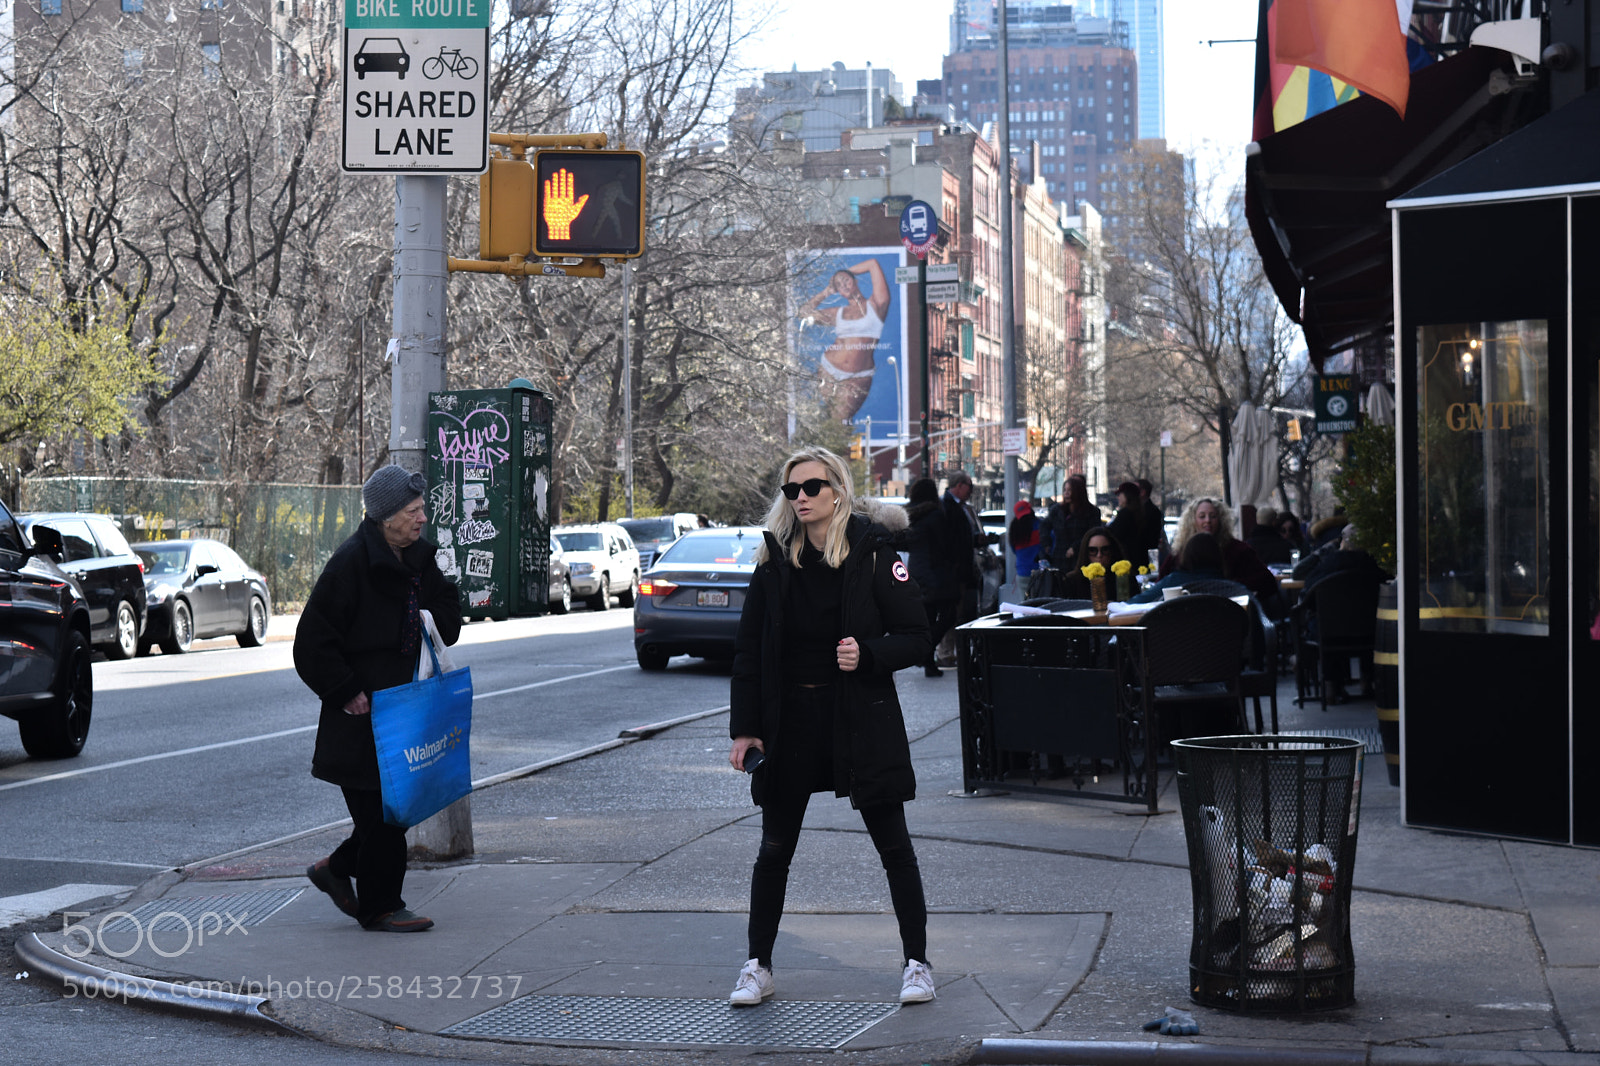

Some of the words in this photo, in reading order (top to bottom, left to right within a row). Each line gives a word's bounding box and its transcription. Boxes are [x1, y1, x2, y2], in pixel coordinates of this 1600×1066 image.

[356, 0, 400, 17] BIKE
[411, 0, 478, 17] ROUTE
[355, 90, 476, 118] SHARED
[374, 128, 454, 156] LANE
[825, 342, 843, 352] your
[403, 734, 448, 764] Walmart
